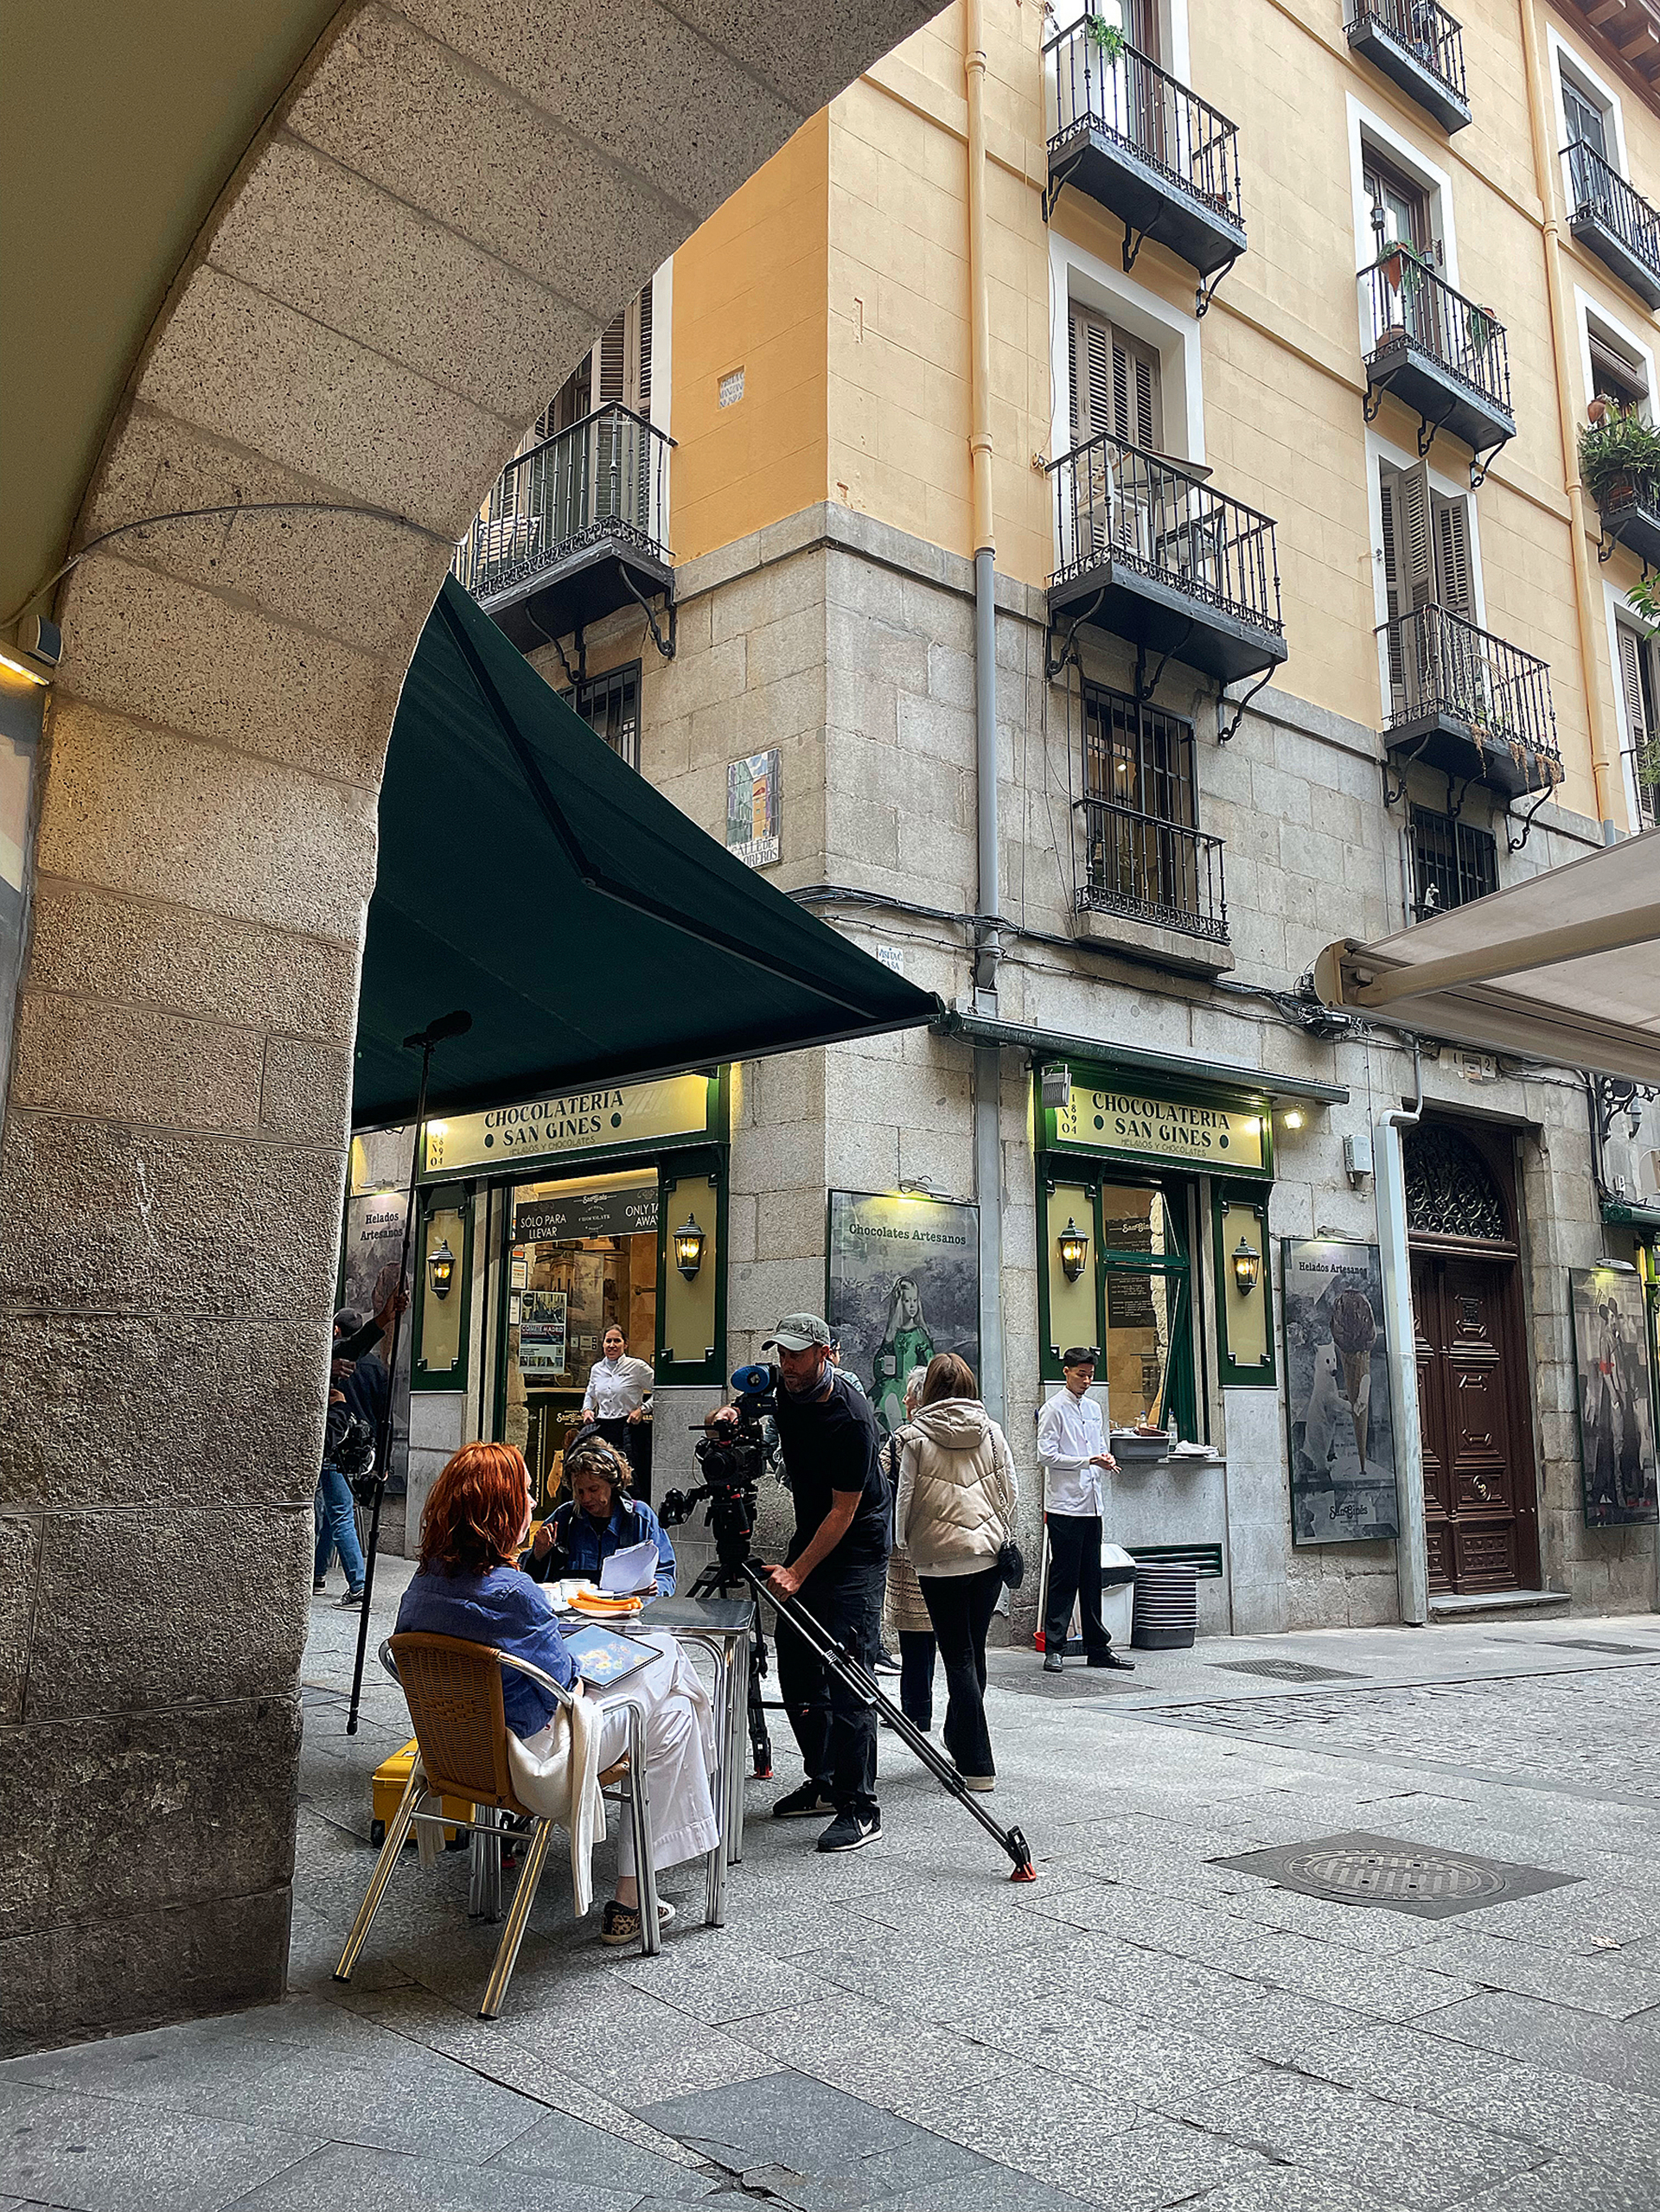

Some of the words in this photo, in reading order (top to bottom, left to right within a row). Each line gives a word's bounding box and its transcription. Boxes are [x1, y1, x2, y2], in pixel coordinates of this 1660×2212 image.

[763, 838, 774, 851] DE
[744, 847, 778, 867] OREROS
[484, 1090, 624, 1128] CHOCOLATERIA
[1092, 1093, 1230, 1131] CHOCOLATERIA
[502, 1125, 540, 1146] SAN
[546, 1115, 602, 1140] GINES
[1114, 1117, 1152, 1139] SAN
[1159, 1125, 1212, 1148] GINES
[509, 1144, 540, 1157] HELADOS
[548, 1136, 596, 1151] CHOCOLATES
[1121, 1138, 1153, 1150] HELADOS
[1161, 1144, 1207, 1157] CHOCOLATES
[365, 1212, 399, 1225] Helados
[625, 1203, 649, 1217] ONLY
[520, 1214, 544, 1228] SÓLO
[545, 1214, 567, 1226] PARA
[360, 1228, 404, 1241] Artesanos
[528, 1226, 558, 1240] LLEVAR
[849, 1223, 910, 1240] Chocolates
[911, 1229, 967, 1245] Artesanos
[1299, 1262, 1329, 1273] Helados
[1330, 1263, 1369, 1275] Artesanos
